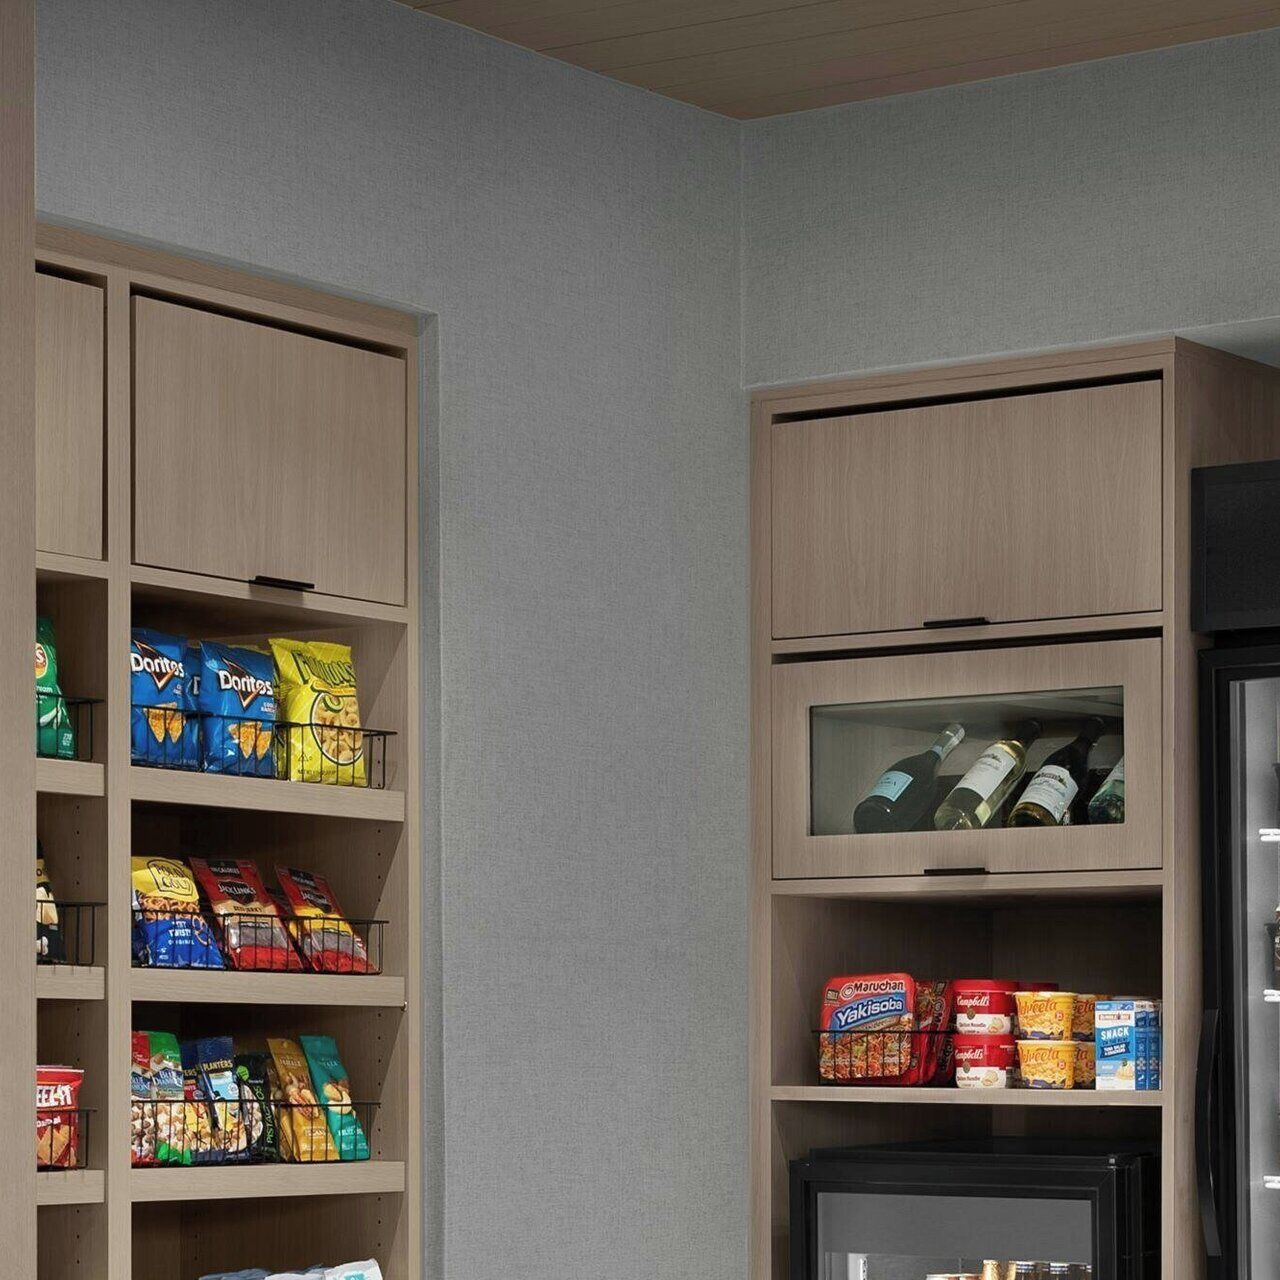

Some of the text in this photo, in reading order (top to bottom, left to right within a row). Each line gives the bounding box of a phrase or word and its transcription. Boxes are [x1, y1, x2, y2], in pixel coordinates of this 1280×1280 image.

[130, 652, 185, 679] Doritos
[36, 685, 54, 693] ream
[218, 670, 275, 696] Doritos
[853, 980, 904, 992] Maruchan
[836, 998, 903, 1027] Yakisoba
[1101, 1027, 1130, 1041] SNACK
[201, 1058, 234, 1071] PLANTERS
